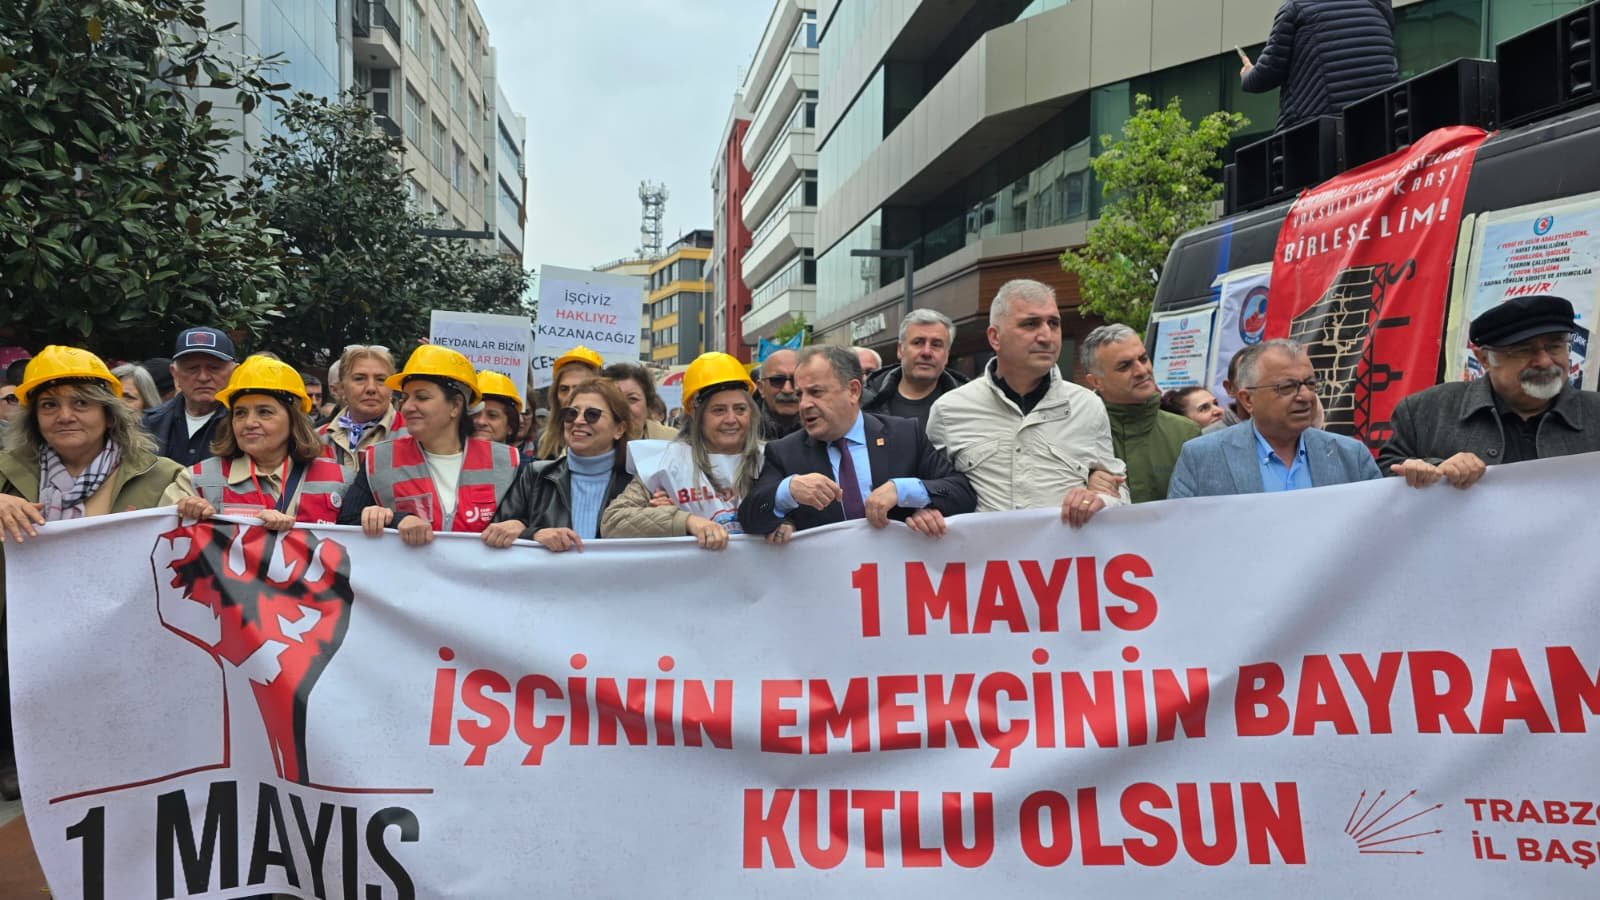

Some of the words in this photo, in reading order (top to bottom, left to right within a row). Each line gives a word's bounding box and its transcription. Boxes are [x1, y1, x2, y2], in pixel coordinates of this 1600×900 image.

[1393, 165, 1458, 196] KARŞI
[565, 289, 611, 306] İŞÇİYİZ
[556, 308, 617, 325] HAKLIYIZ
[433, 336, 496, 351] MEYDANLAR
[498, 340, 525, 352] BİZİM
[538, 325, 636, 345] KAZANACAĞIZ
[494, 354, 521, 367] BİZİM
[852, 564, 880, 637] 1
[906, 553, 1158, 635] MAYIS
[429, 646, 733, 766] İŞÇİNİN
[761, 645, 1210, 768] EMEKÇİNİN
[743, 788, 994, 869] KUTLU
[1019, 781, 1306, 867] OLSUN
[1464, 798, 1600, 825] TRABZ
[66, 806, 105, 900] 1
[156, 780, 419, 900] MAYIS
[1472, 830, 1507, 860] İL
[1517, 838, 1600, 869] BAŞ
